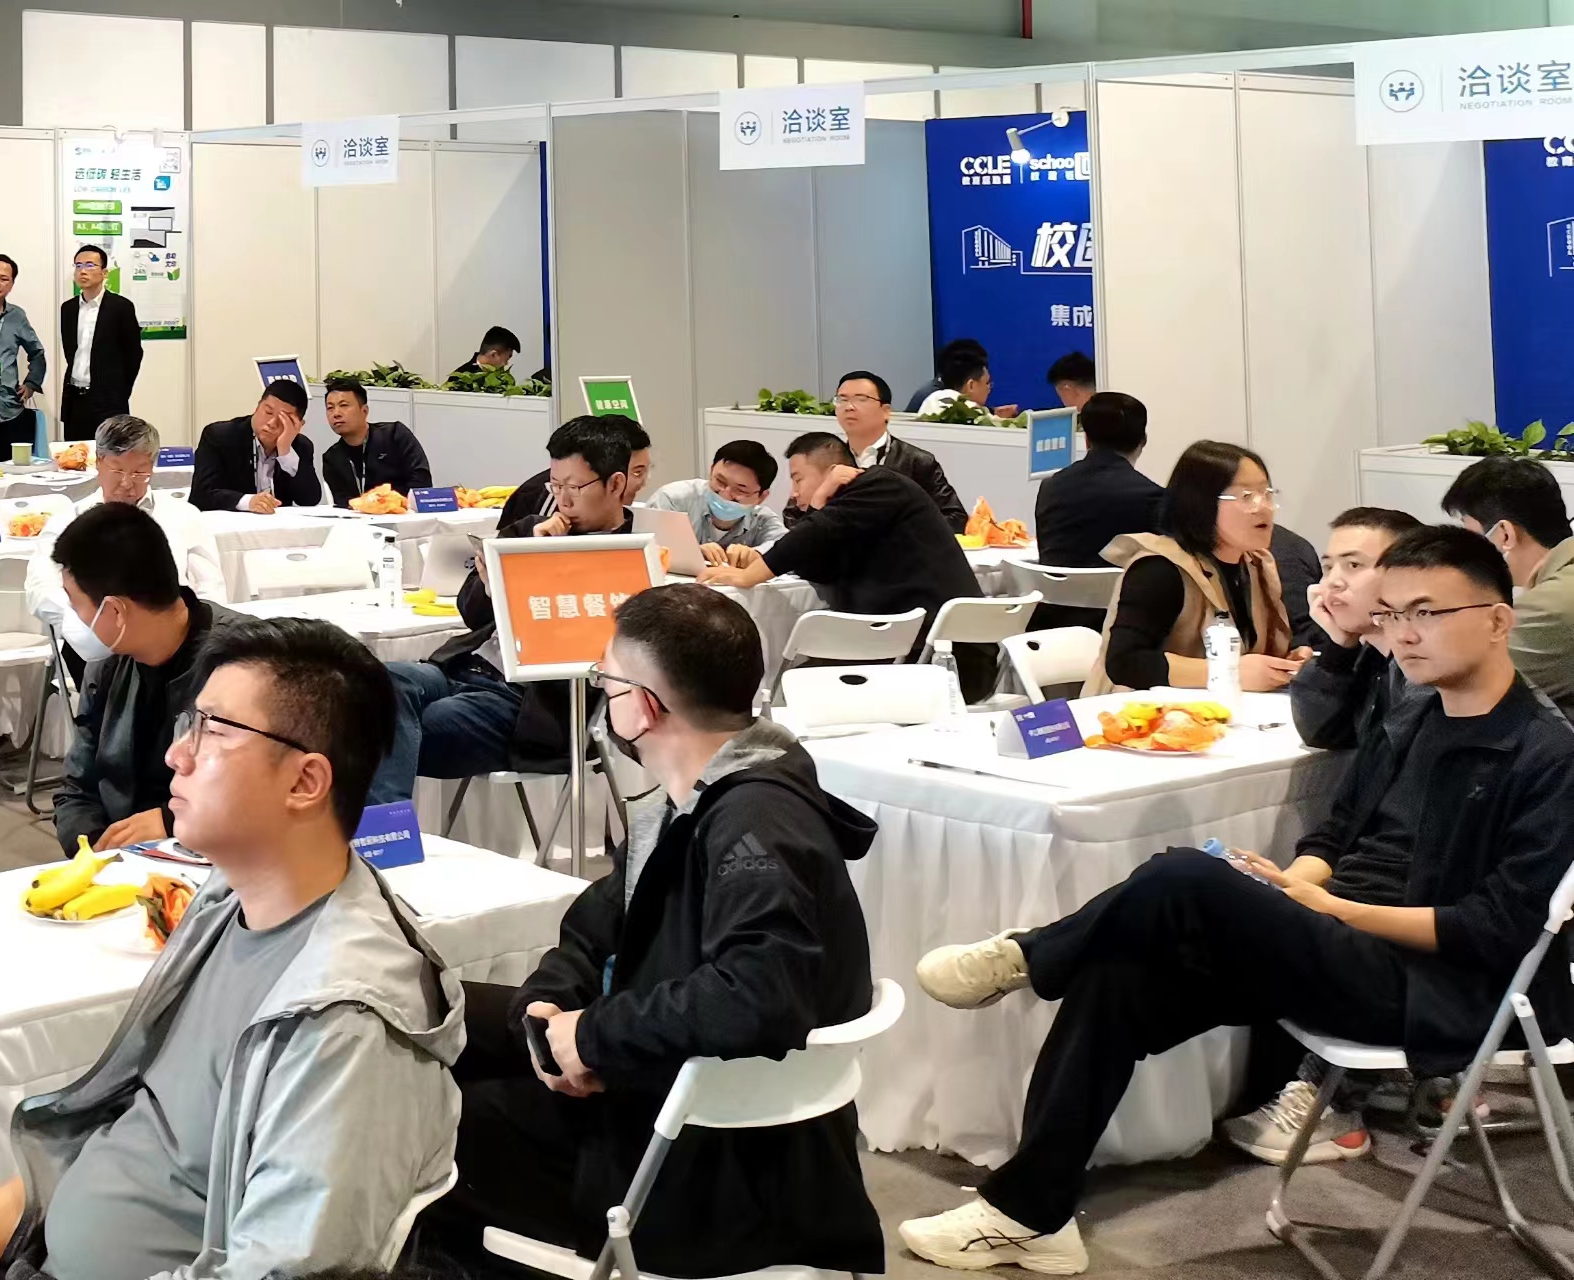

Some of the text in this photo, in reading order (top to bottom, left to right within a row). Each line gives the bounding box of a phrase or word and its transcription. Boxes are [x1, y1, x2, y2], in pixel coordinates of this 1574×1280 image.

[1458, 60, 1573, 98] 洽谈室
[1460, 97, 1573, 110] NEGOTIATION ROOM
[782, 106, 851, 134] 洽谈室
[343, 136, 390, 158] 洽谈室
[960, 155, 1011, 175] CCLE
[1050, 305, 1093, 327] 集成
[717, 857, 779, 876] adidas
